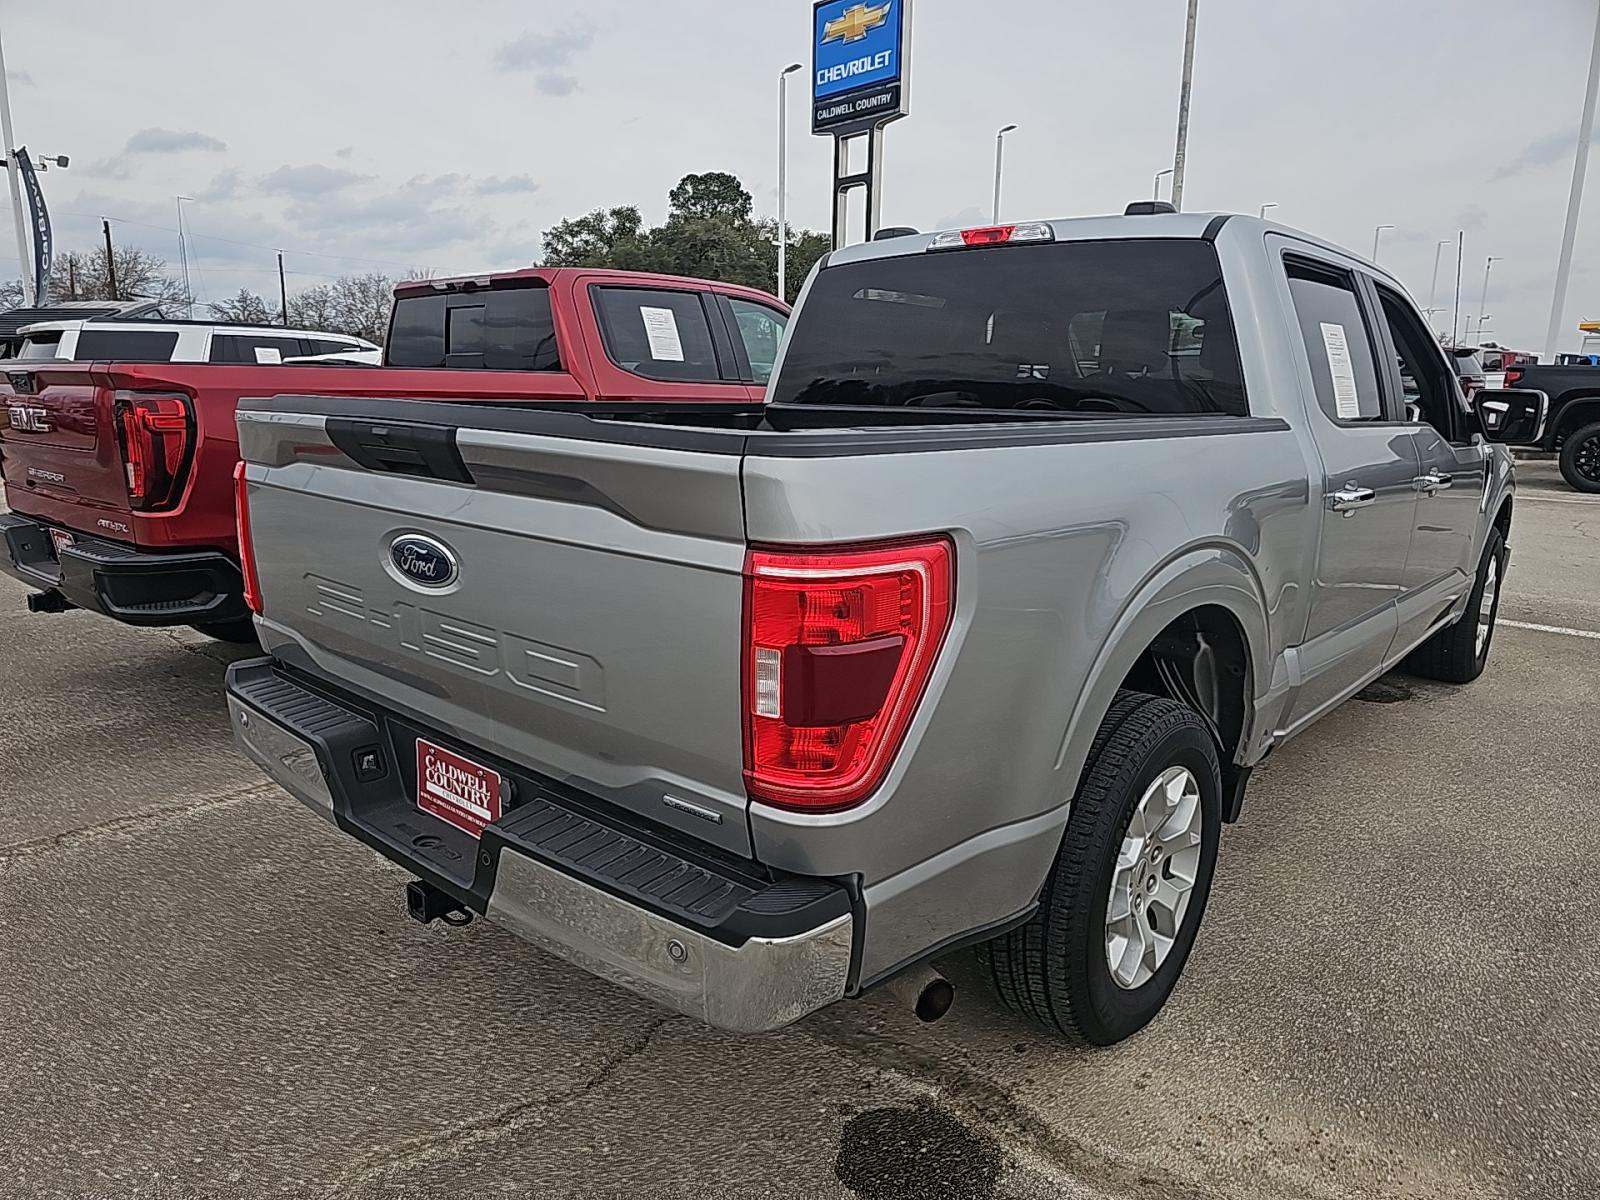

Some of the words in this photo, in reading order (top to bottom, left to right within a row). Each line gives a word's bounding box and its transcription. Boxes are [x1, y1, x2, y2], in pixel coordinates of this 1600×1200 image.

[817, 50, 892, 85] CHEVROLET
[817, 103, 854, 120] CALDWELL
[855, 92, 892, 111] COUNTRY
[27, 170, 50, 270] CarBravo
[8, 407, 49, 432] GMC
[401, 544, 437, 577] Ford
[303, 572, 606, 712] F-150
[425, 755, 491, 797] CALDWELL
[426, 767, 491, 809] COUNTRY
